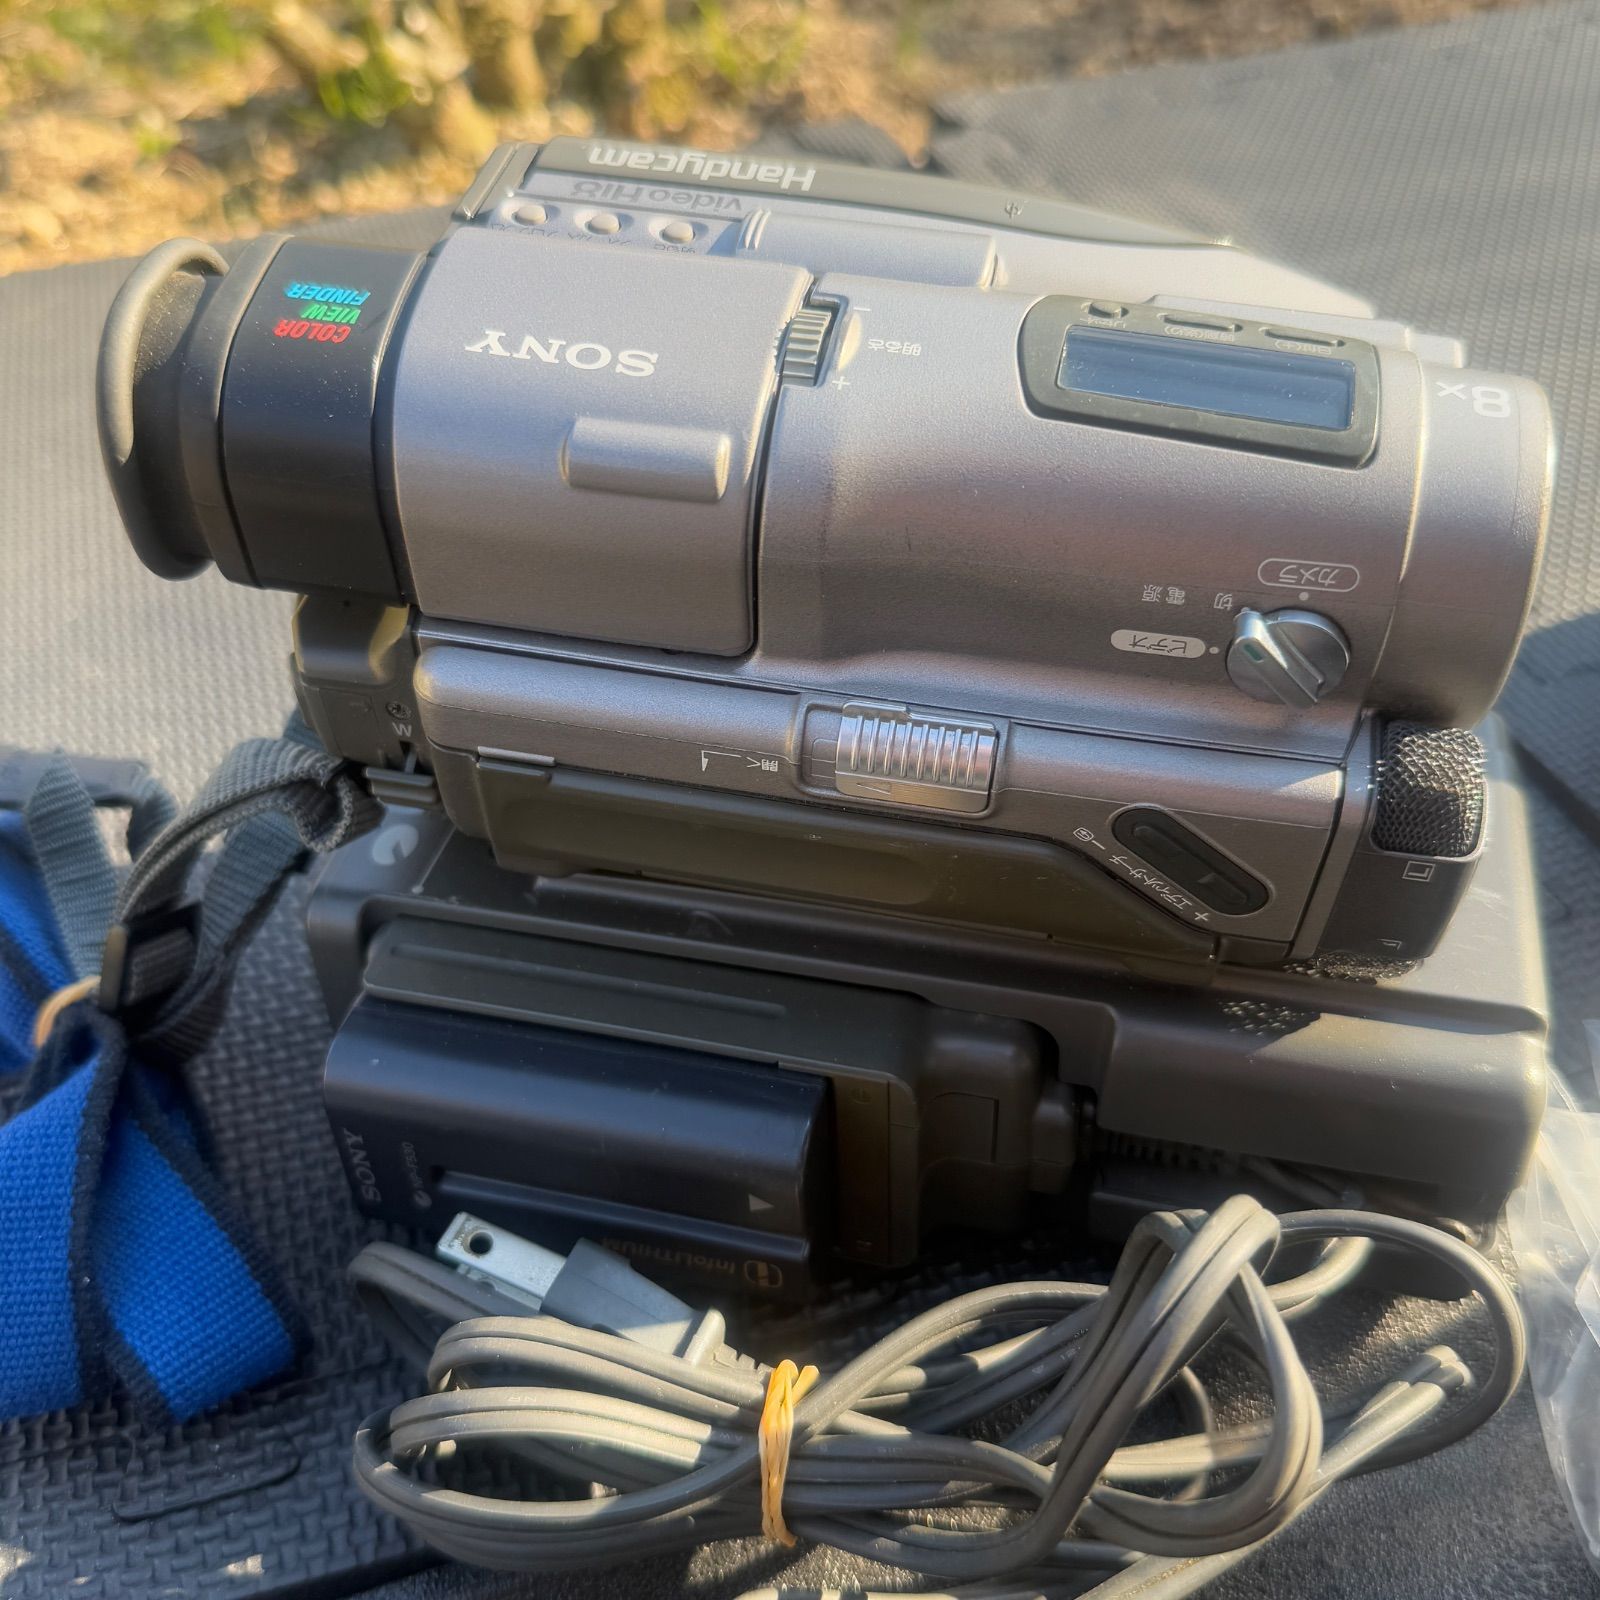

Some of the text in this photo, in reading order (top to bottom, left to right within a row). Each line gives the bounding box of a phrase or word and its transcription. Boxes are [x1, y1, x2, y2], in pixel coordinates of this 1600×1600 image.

[587, 145, 817, 193] Handycam
[284, 280, 371, 306] FINDER
[299, 302, 362, 325] VIEW
[272, 319, 352, 344] COLOR
[463, 328, 660, 378] SONY
[1278, 564, 1341, 588] カメラ
[1213, 592, 1233, 611] 切
[1128, 633, 1188, 656] ビデオ
[391, 721, 412, 738] W
[1108, 854, 1193, 910] エディットサーチ
[342, 1127, 382, 1202] SONY
